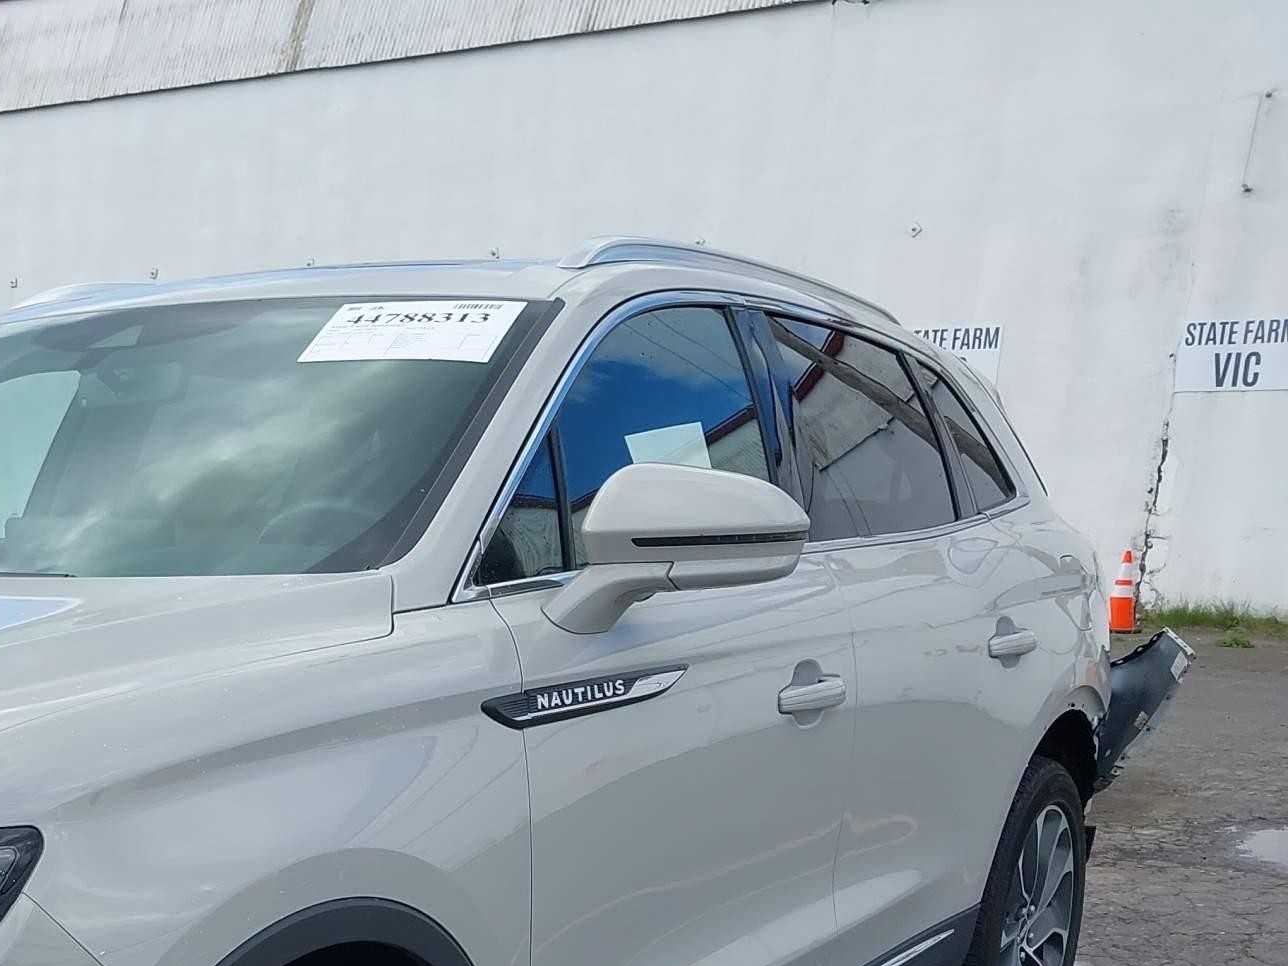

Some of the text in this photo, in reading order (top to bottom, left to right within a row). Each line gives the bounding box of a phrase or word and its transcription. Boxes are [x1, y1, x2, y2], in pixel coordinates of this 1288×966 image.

[346, 312, 491, 324] 44788313
[952, 326, 1001, 350] FARM
[1185, 321, 1240, 346] STATE
[1214, 351, 1262, 388] VIC
[536, 679, 625, 709] NAUTILUS
